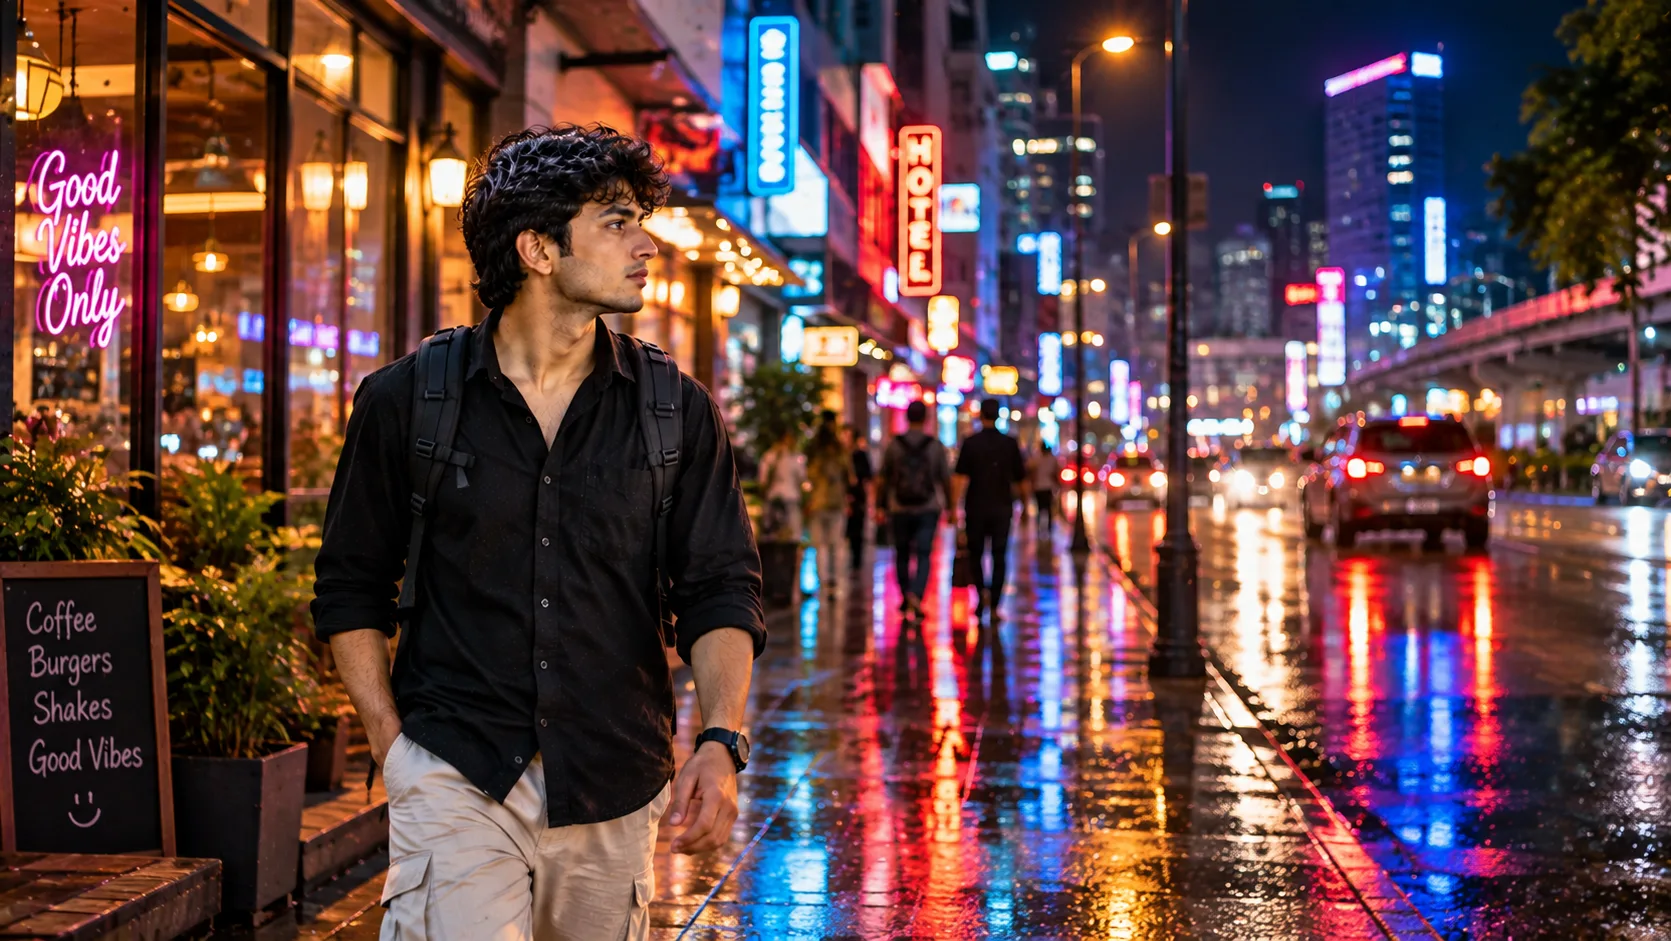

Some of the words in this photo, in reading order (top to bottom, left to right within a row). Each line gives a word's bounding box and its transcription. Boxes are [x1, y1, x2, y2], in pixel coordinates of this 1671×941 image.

[37, 149, 122, 225] Good
[37, 210, 127, 273] Vibes
[45, 267, 126, 348] Only
[26, 600, 97, 640] Coffee
[28, 645, 113, 686] Burgers
[33, 690, 113, 725] Shakes
[28, 738, 82, 778] Good
[88, 736, 144, 771] Vibes
